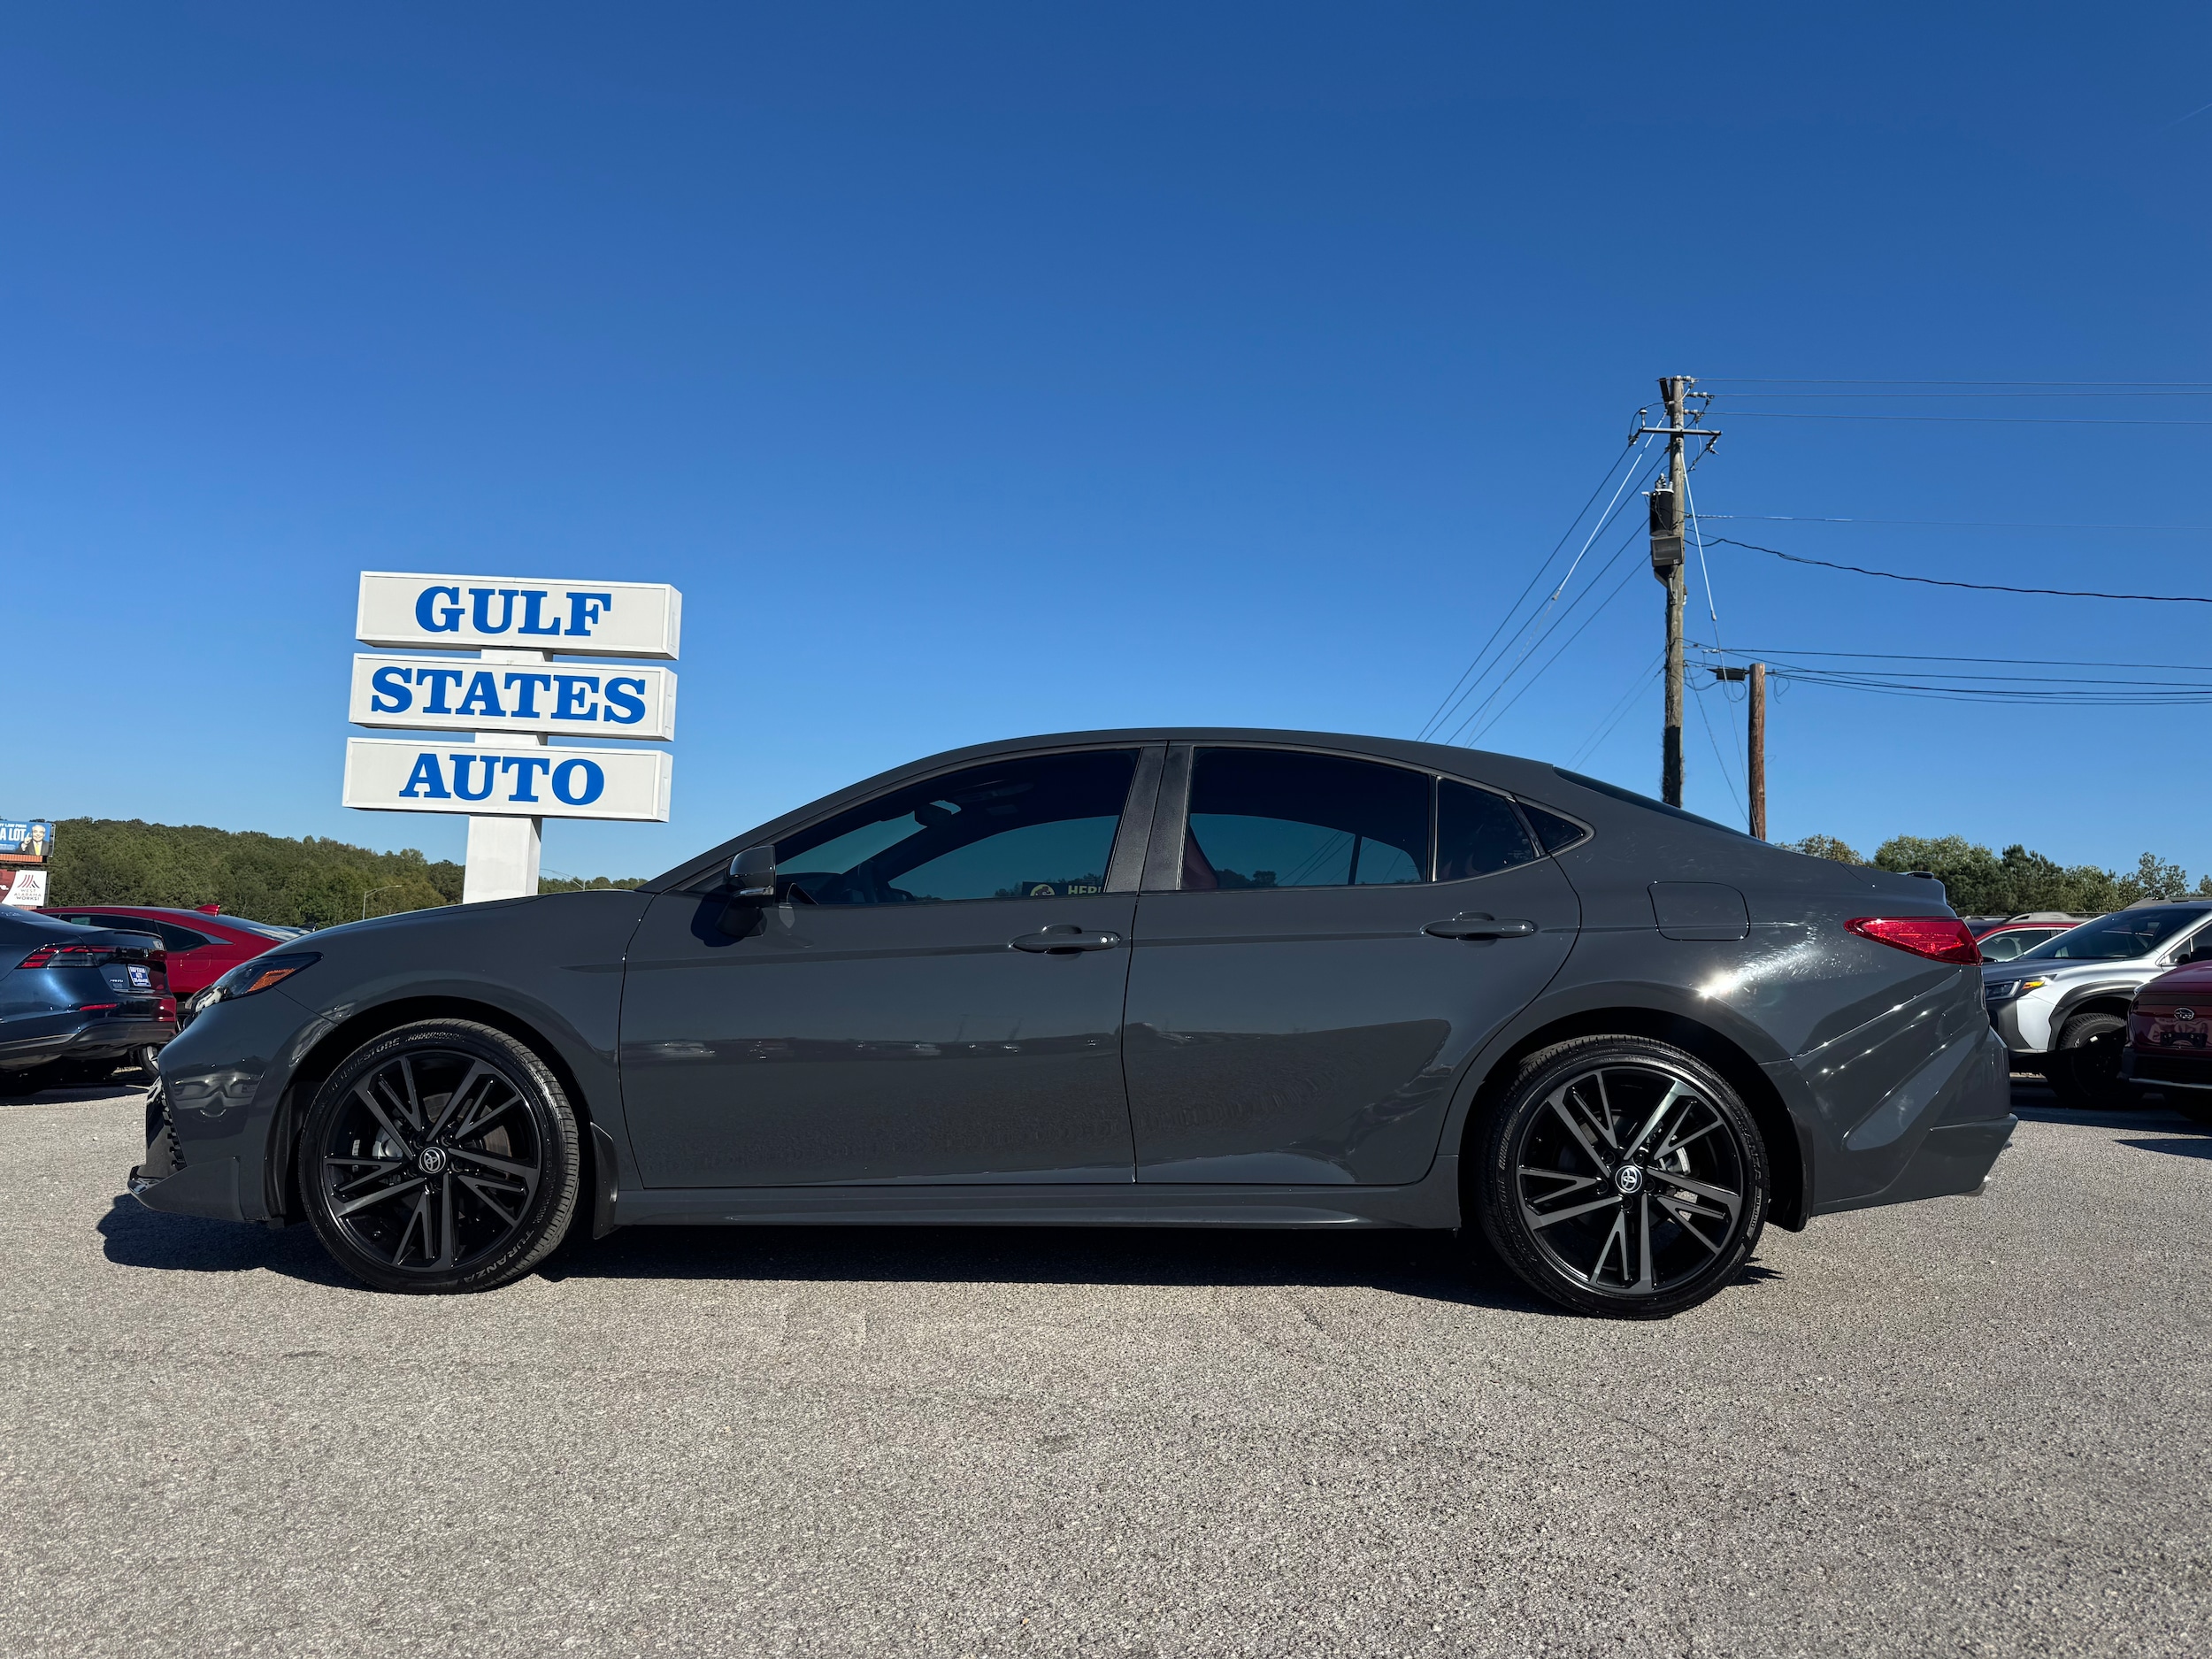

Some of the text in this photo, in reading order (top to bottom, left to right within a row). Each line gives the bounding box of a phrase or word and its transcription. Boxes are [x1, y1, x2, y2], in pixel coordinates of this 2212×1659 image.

[415, 586, 611, 637] GULF
[371, 666, 647, 725] STATES
[399, 753, 605, 806] AUTO
[8, 827, 27, 842] LOT
[463, 1230, 535, 1284] TURANZA
